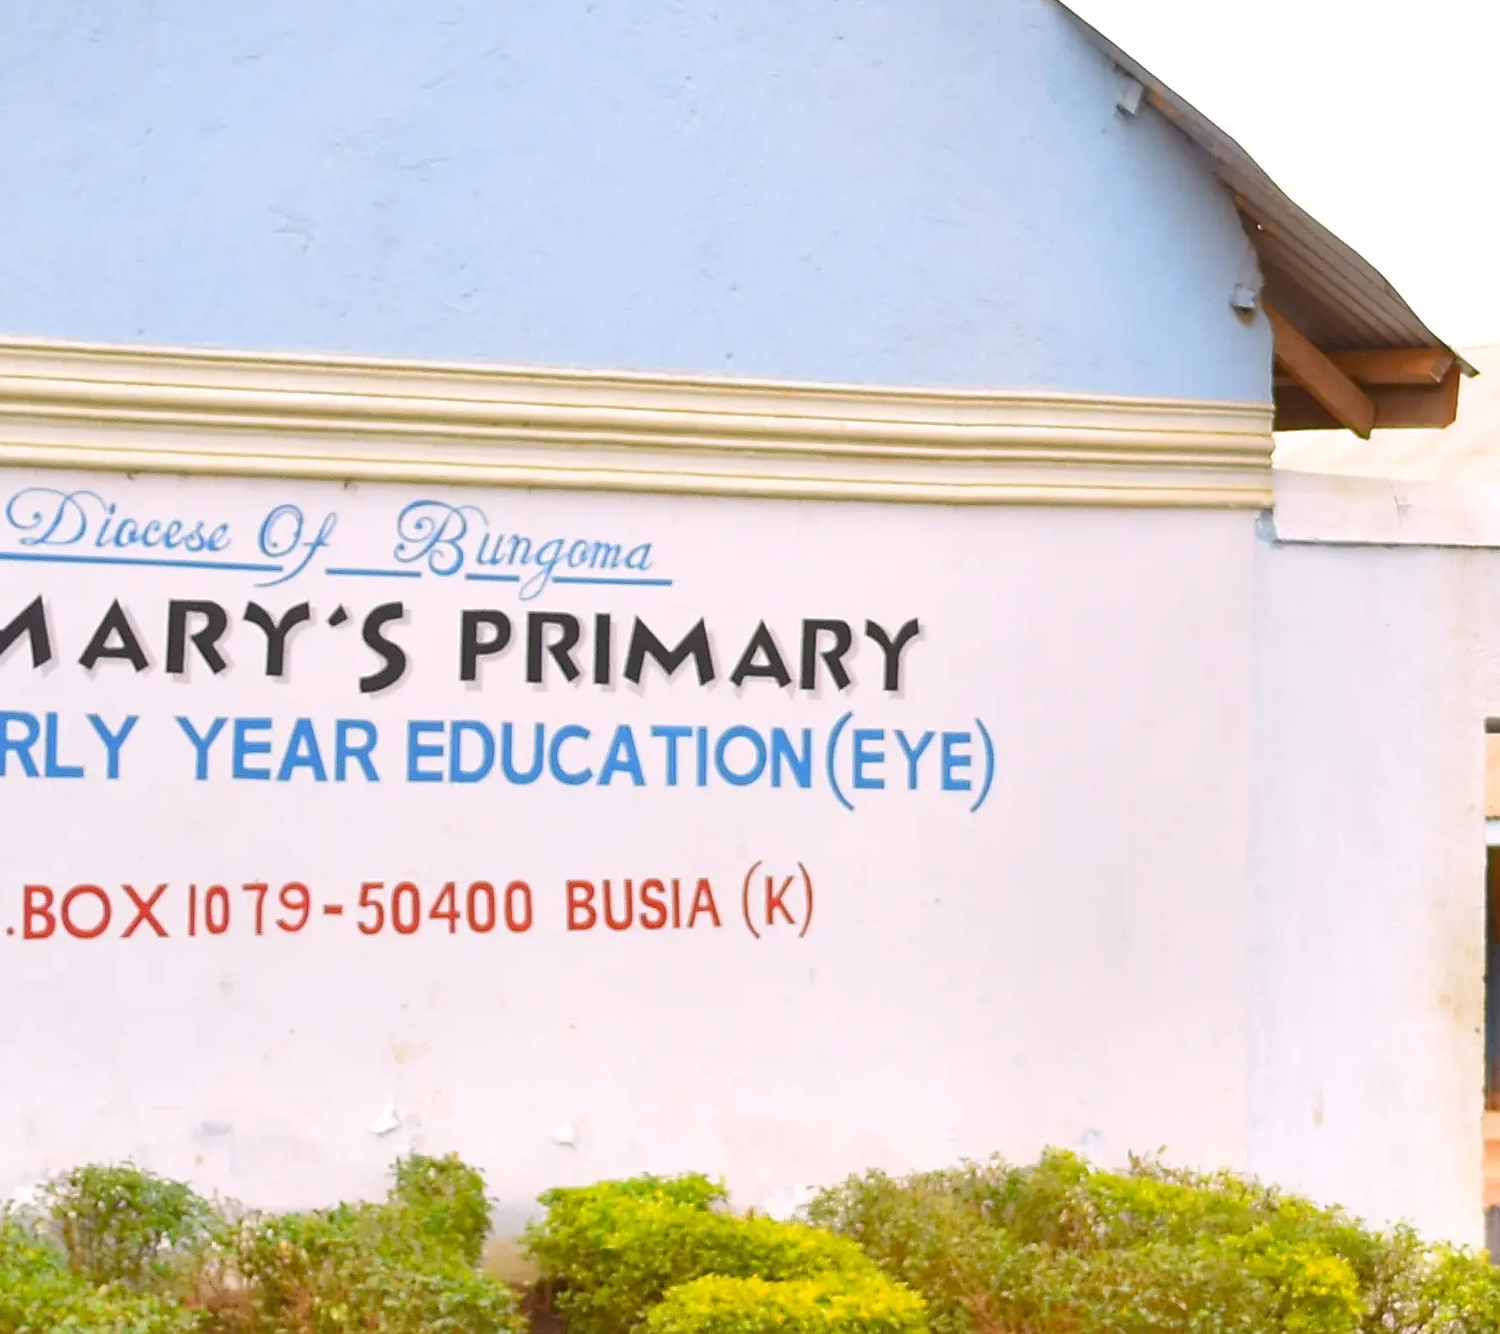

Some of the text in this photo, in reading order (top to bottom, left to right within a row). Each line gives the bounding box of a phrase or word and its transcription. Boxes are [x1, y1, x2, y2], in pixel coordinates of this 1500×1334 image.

[4, 486, 232, 554] Diocese
[253, 504, 337, 587] Of
[393, 498, 654, 601] Bungoma
[461, 611, 919, 691] PRIMARY
[176, 716, 380, 782] YEAR
[566, 878, 722, 931] BUSIA
[742, 861, 813, 939] (K)
